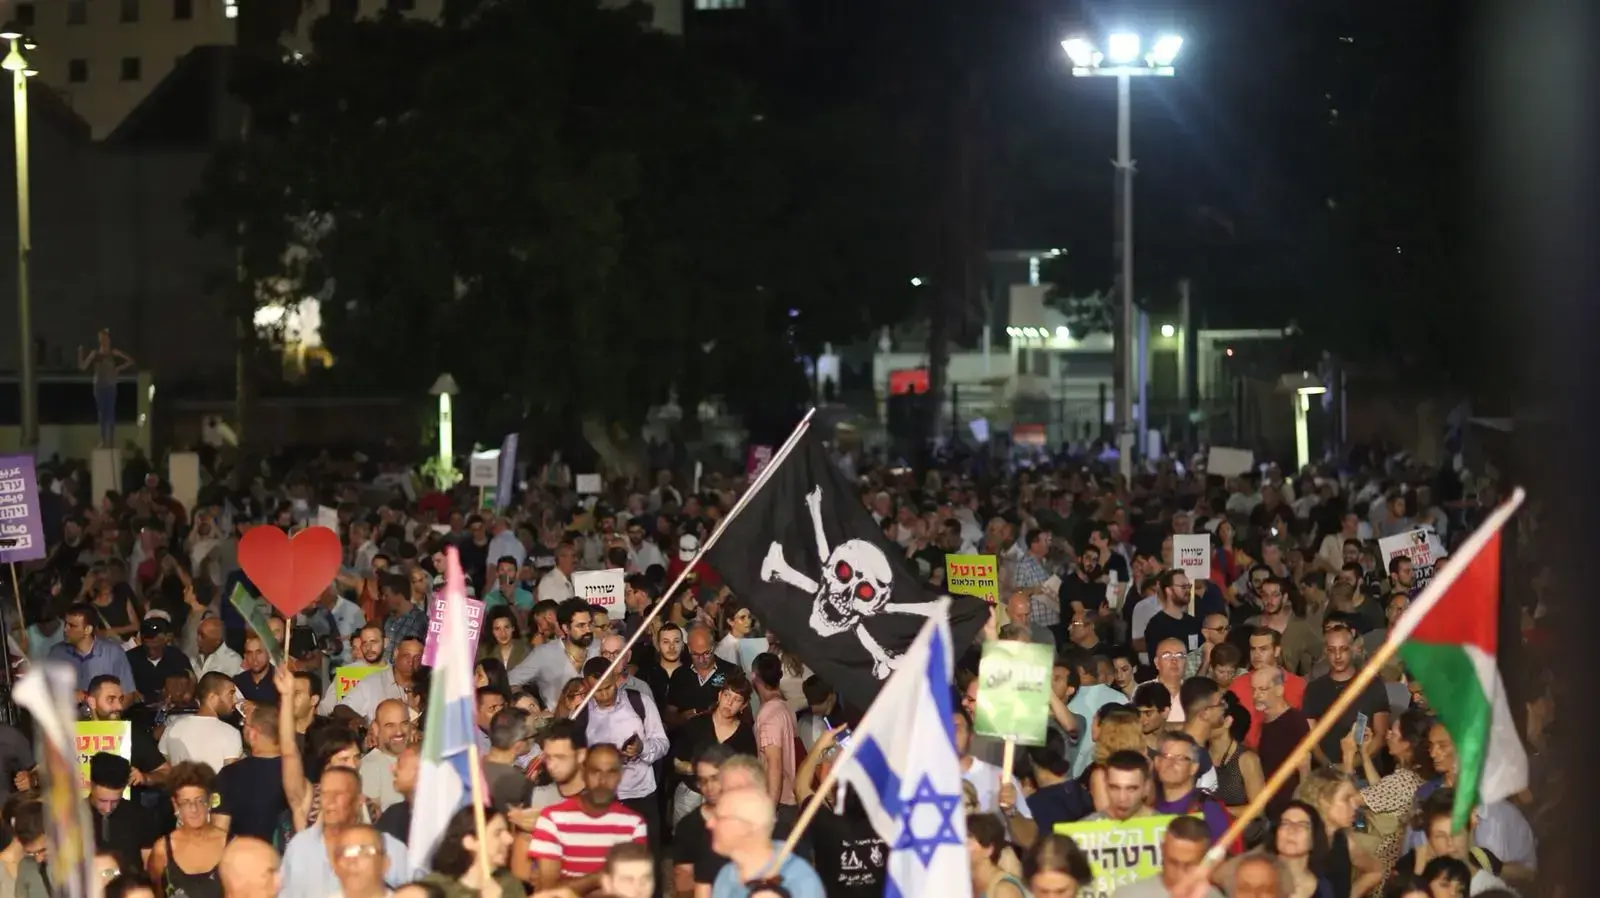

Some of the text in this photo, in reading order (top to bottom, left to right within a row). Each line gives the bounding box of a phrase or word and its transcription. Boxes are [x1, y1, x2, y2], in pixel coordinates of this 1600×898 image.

[950, 562, 993, 576] יבוטל
[951, 578, 994, 588] חוק הלאום
[585, 584, 615, 597] שוויון
